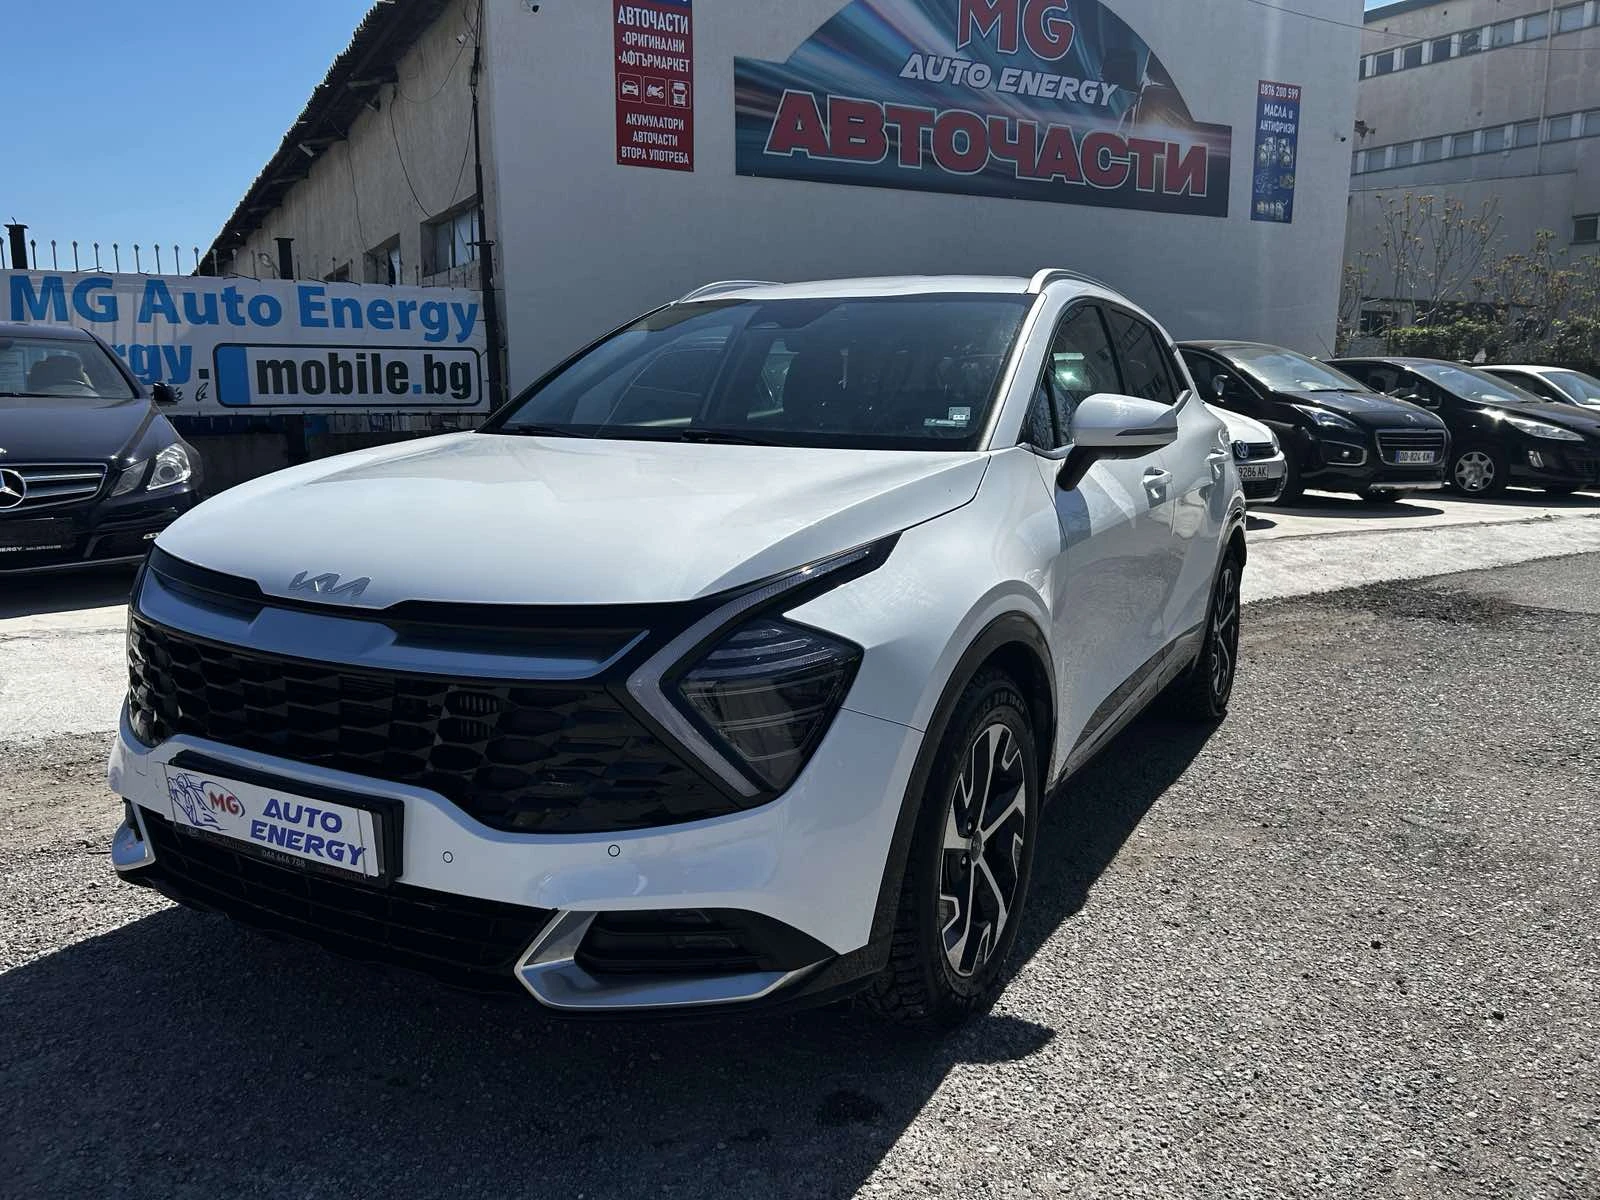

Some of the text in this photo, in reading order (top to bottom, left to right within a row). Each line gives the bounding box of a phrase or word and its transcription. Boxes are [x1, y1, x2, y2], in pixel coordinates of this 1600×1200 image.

[617, 5, 689, 35] АВТОЧАСТИ
[957, 0, 1076, 61] MG
[899, 52, 1118, 106] AUTO ENERGY
[1275, 86, 1287, 98] 200
[625, 113, 685, 131] АКУМУЛАТОРИ
[1264, 103, 1287, 118] МАСЛА
[632, 130, 678, 147] АВТОЧАСТИ
[763, 88, 1209, 197] АВТОЧАСТИ
[621, 146, 689, 164] ВТОРА УПОТРЕБА
[9, 275, 480, 344] MG Auto Energy
[256, 352, 473, 400] mobile.bg
[1238, 466, 1257, 478] 9286
[209, 790, 240, 816] MG
[262, 798, 343, 834] AUTO
[250, 819, 367, 866] ENERGY
